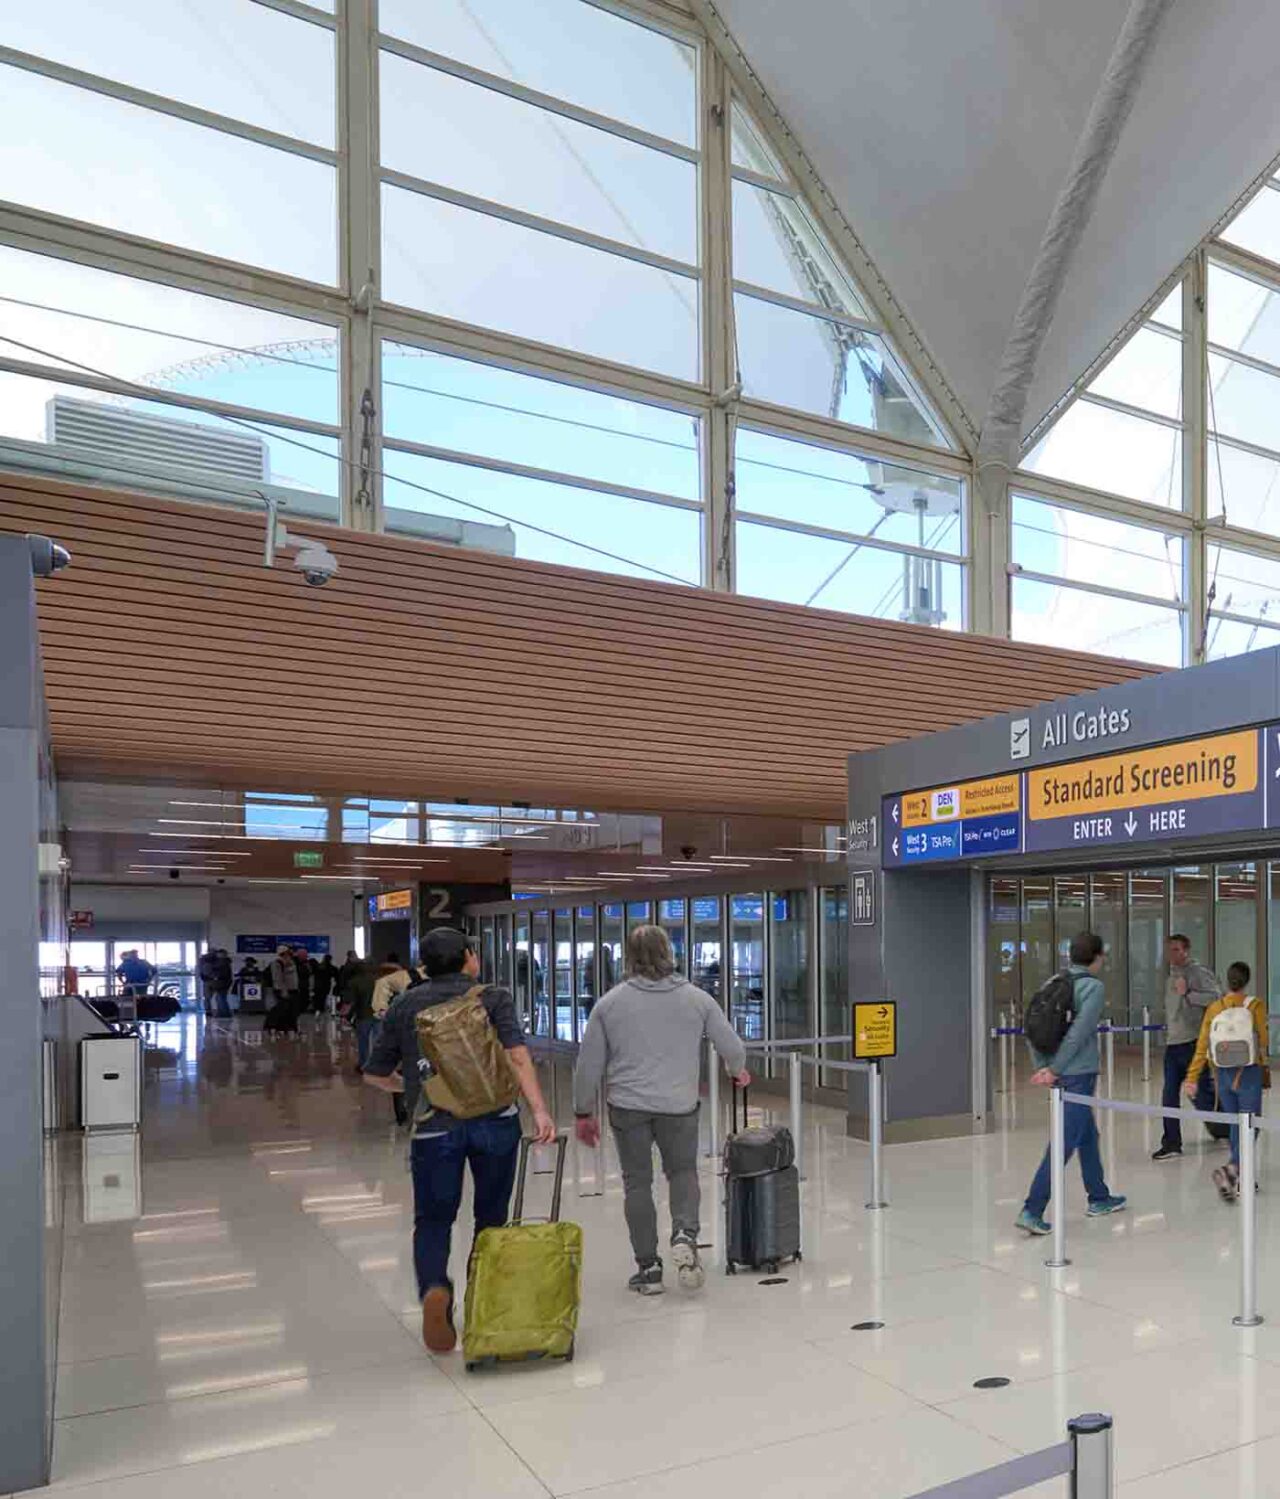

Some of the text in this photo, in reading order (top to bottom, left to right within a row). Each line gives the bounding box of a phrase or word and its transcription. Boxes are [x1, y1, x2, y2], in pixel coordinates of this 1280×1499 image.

[1041, 706, 1131, 749] All Gates
[1043, 750, 1237, 806] Standard Screening
[921, 797, 928, 818] 2
[937, 791, 953, 806] DEN
[849, 815, 877, 848] West 1
[1073, 808, 1187, 840] ENTER HERE
[920, 832, 928, 853] 3
[428, 888, 453, 919] 2
